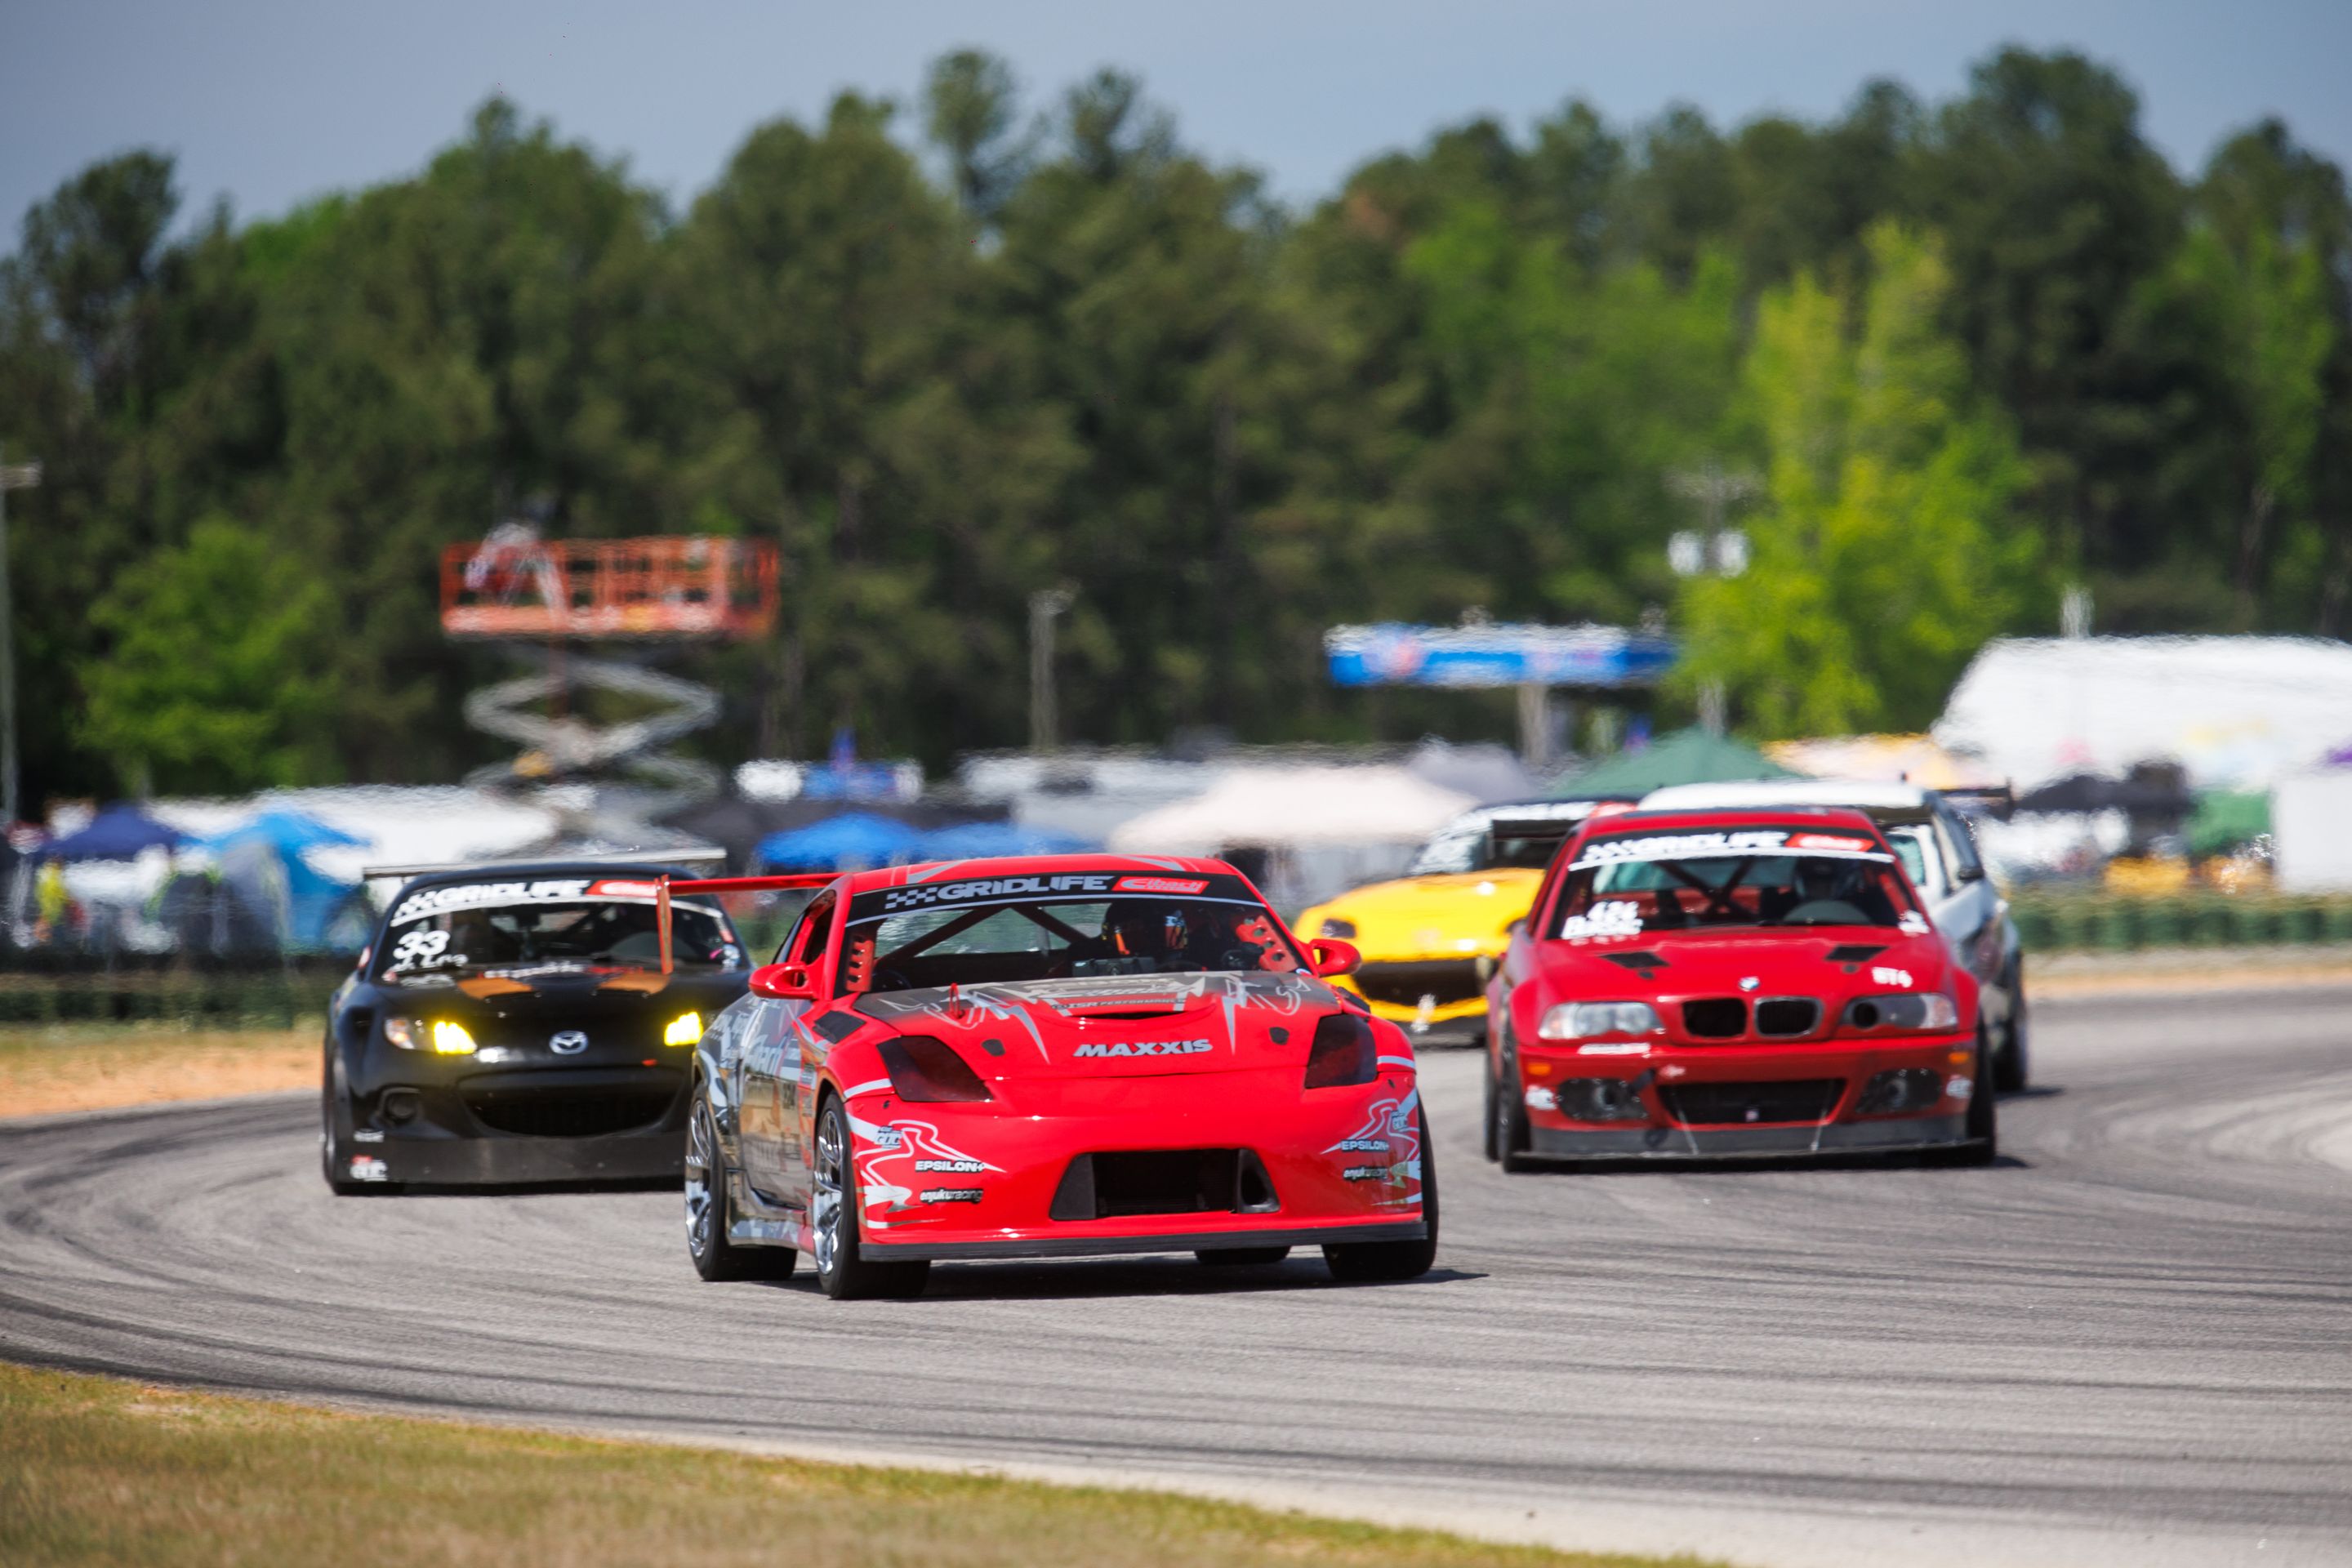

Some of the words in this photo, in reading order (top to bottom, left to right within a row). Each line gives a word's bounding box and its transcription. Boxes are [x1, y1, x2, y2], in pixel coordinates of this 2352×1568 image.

[937, 875, 1115, 899] GRIDLIFE
[393, 930, 451, 959] 33
[1073, 1039, 1214, 1058] MAXXIS
